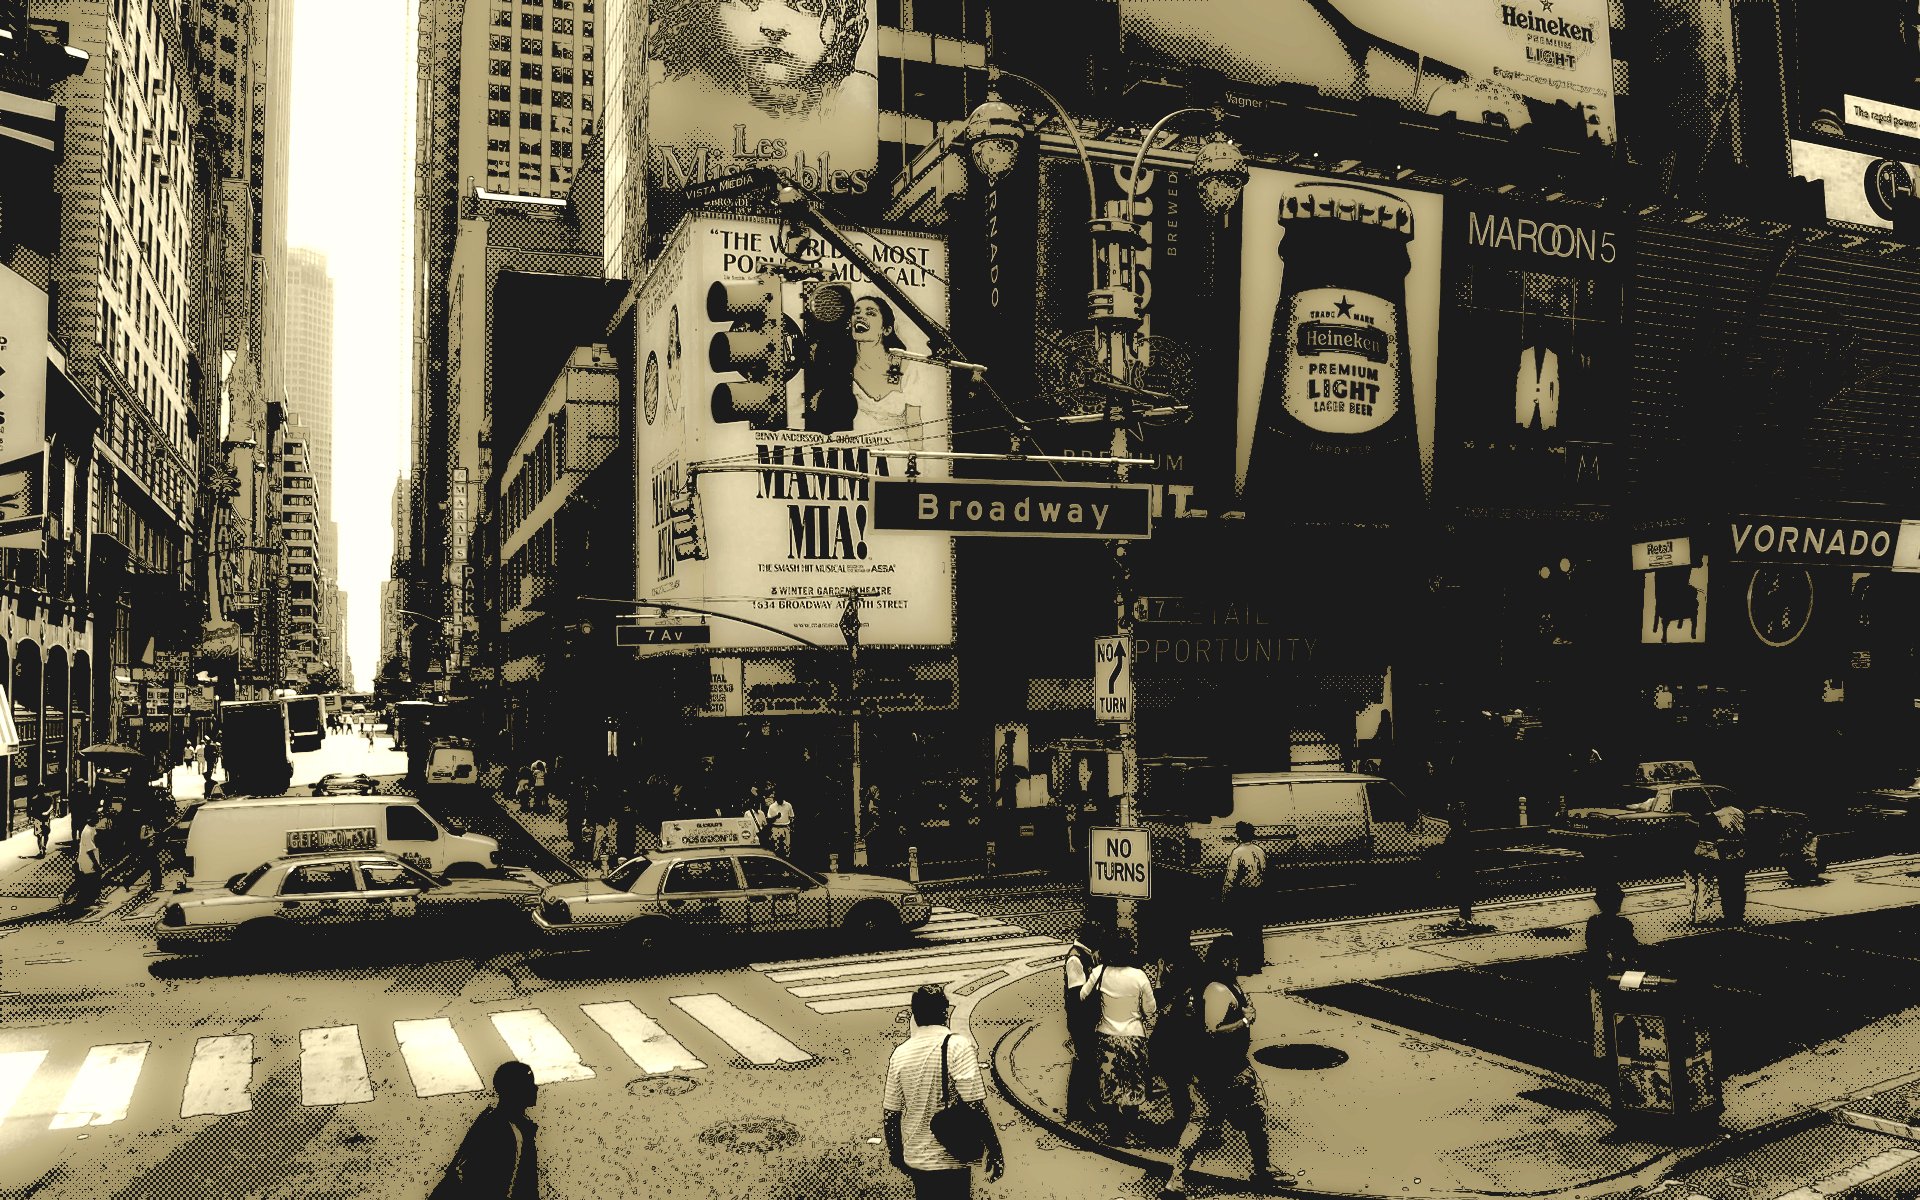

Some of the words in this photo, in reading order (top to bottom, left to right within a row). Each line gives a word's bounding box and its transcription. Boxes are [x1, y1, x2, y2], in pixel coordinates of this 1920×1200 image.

[1501, 4, 1595, 43] Heineken
[1527, 33, 1572, 50] PREMIUM
[1526, 46, 1577, 70] LIGHT
[1854, 105, 1869, 119] The
[732, 124, 788, 159] Les
[685, 184, 716, 200] VISTA
[719, 174, 754, 192] MEDIA
[1167, 171, 1178, 256] BREWED
[988, 178, 999, 308] RNADO
[1469, 211, 1596, 261] MAROON
[1600, 232, 1616, 263] 5
[872, 244, 930, 266] MOST
[1310, 310, 1335, 319] TRADE
[1353, 313, 1375, 325] MARK
[1306, 329, 1380, 353] Heineken
[1308, 362, 1379, 382] PREMIUM
[1307, 379, 1380, 405] LIGHT
[1313, 400, 1345, 413] LAGER
[1349, 402, 1373, 417] BEER
[917, 492, 1110, 531] Broadway
[786, 504, 868, 561] MIA!
[1731, 523, 1891, 557] VORNADO
[1647, 541, 1673, 556] Retail
[758, 563, 772, 573] THE
[773, 563, 800, 573] SMASH
[801, 563, 814, 573] HIT
[815, 563, 847, 573] MUSICAL
[780, 586, 814, 596] WINTER
[817, 586, 851, 596] GARDEN
[752, 600, 775, 609] 1634
[778, 600, 832, 610] BROADWAY
[876, 600, 908, 610] STREET
[645, 629, 654, 641] 7
[660, 629, 683, 641] Av
[1097, 643, 1115, 663] NO
[1134, 638, 1318, 663] PPORTUNITY
[1099, 696, 1127, 714] TURN
[1106, 838, 1132, 859] NO
[1094, 861, 1146, 884] TURNS
